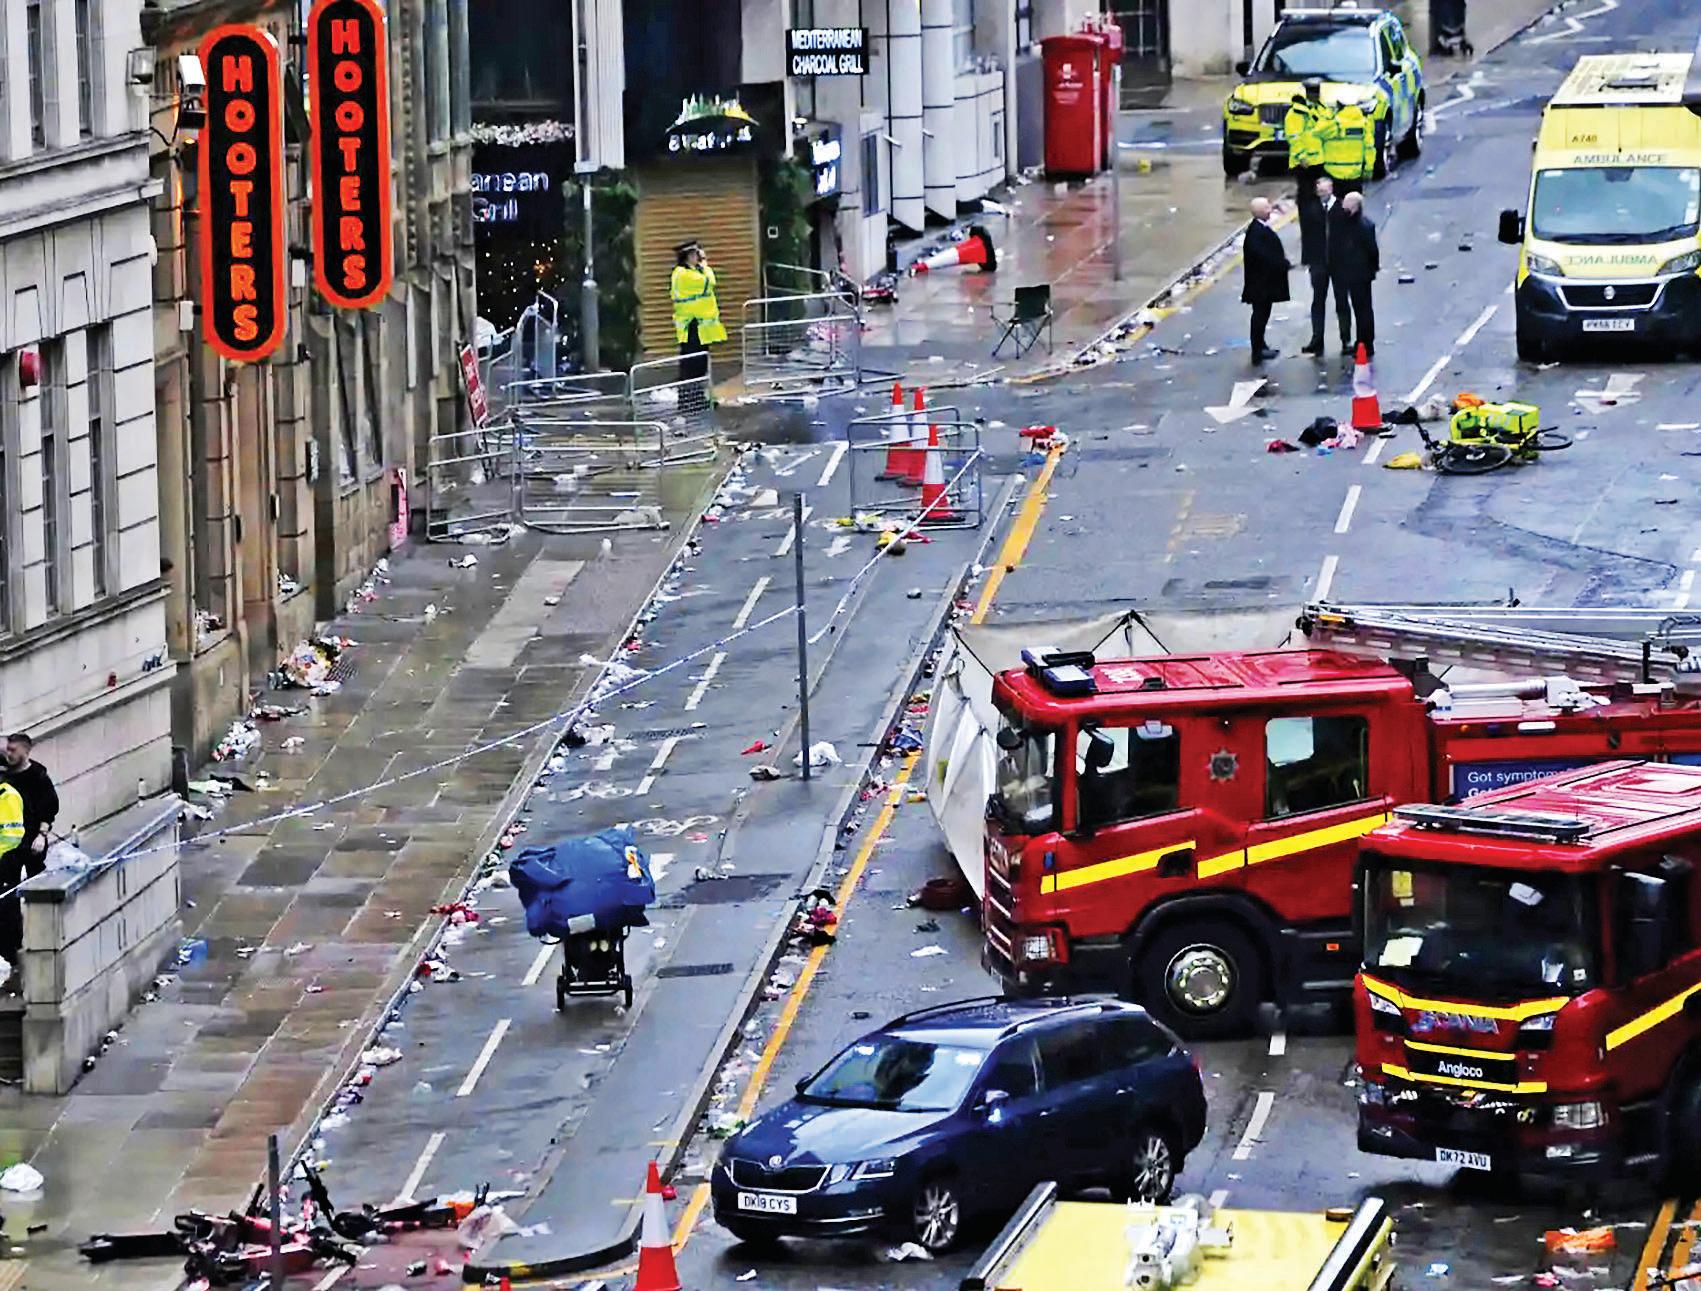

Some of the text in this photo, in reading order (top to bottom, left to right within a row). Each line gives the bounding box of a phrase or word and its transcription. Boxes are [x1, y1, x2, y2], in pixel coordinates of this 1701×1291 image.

[791, 28, 862, 49] MEDITERRANEAN
[792, 54, 864, 75] CHARCOAL GRILL
[331, 19, 366, 289] HOOTERS
[1573, 153, 1667, 164] AMBULANCE
[222, 55, 259, 341] HOOTERS
[1467, 772, 1492, 783] Got
[1438, 1060, 1483, 1078] Angloco
[769, 1198, 790, 1211] CYS
